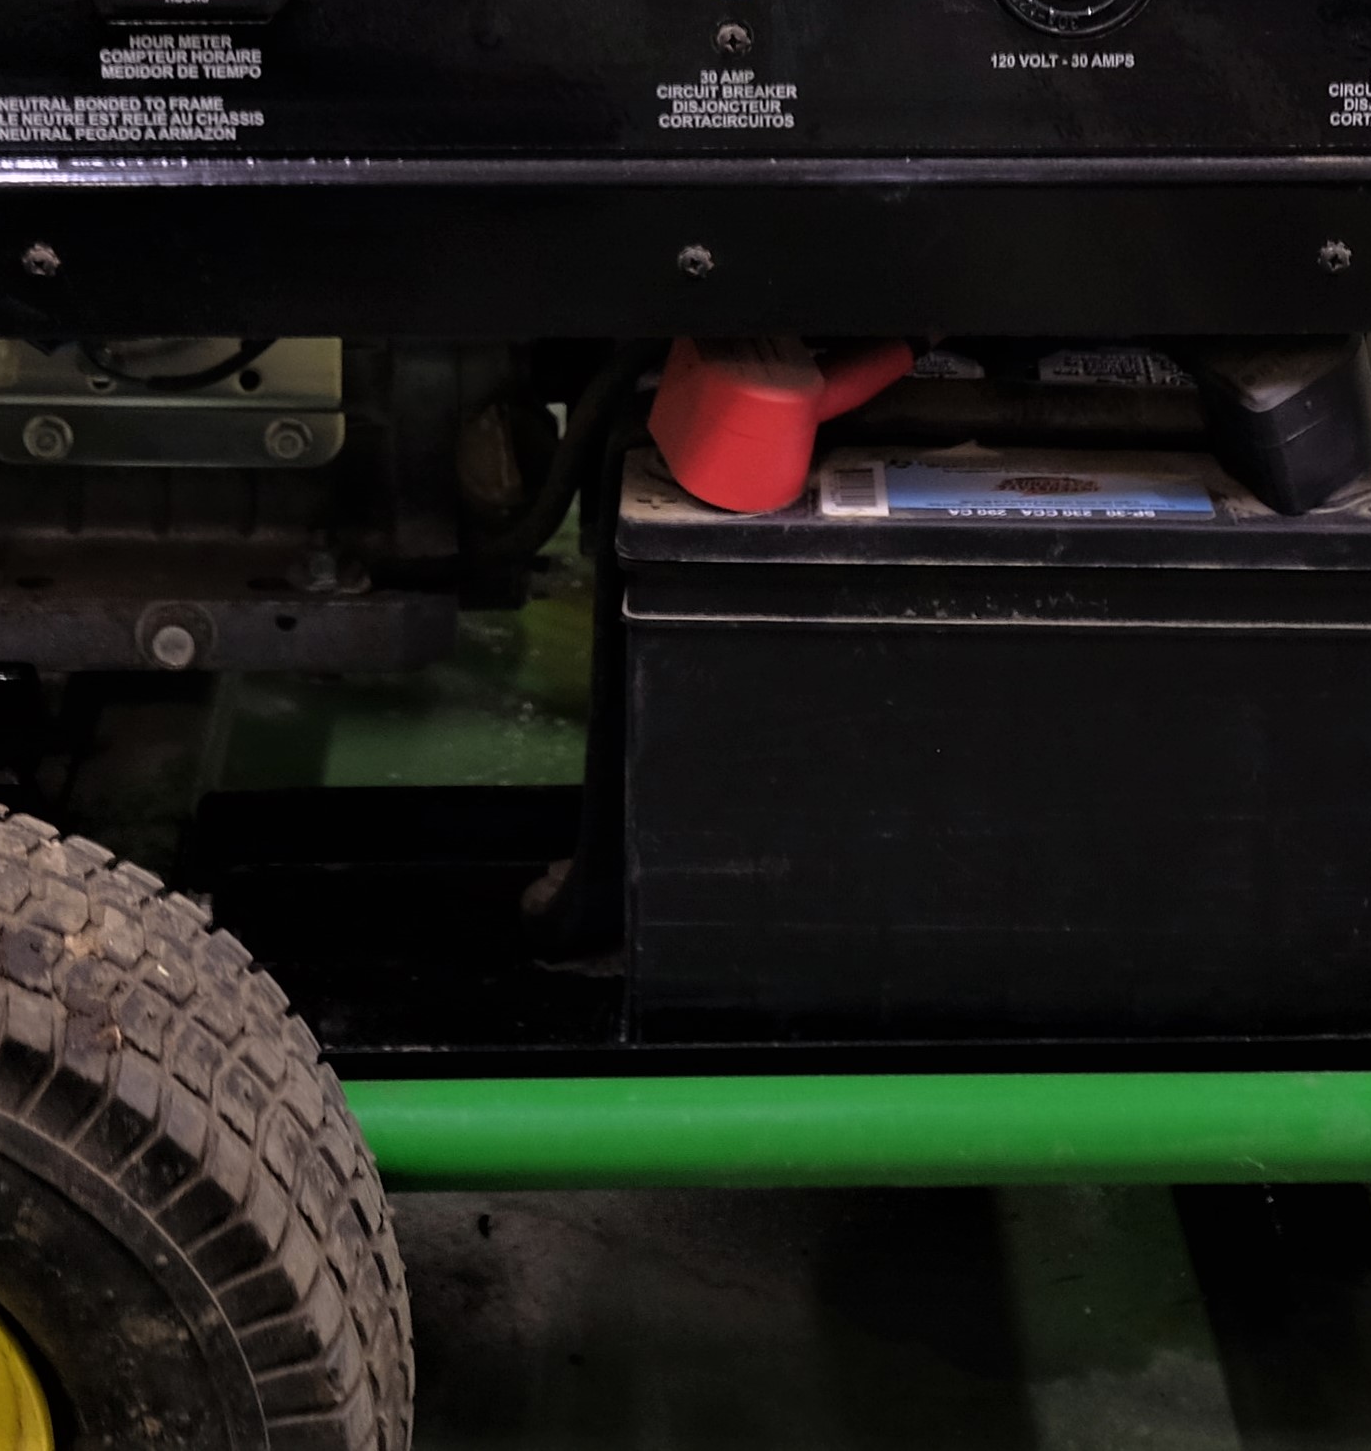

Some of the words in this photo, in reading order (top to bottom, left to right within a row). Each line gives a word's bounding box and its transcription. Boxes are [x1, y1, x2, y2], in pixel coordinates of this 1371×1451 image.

[129, 35, 175, 50] HOUR
[178, 35, 233, 50] METER
[99, 49, 188, 64] COMPTEUR
[190, 49, 262, 64] HORAIRE
[990, 53, 1016, 69] 120
[1018, 54, 1059, 68] VOLT
[1071, 54, 1089, 68] 30
[1091, 53, 1135, 68] AMPS
[100, 64, 174, 80] MEDIDOR
[176, 64, 199, 79] DE
[202, 64, 262, 79] TIEMPO
[700, 69, 718, 85] 30
[719, 70, 755, 85] AMP
[656, 84, 719, 99] CIRCUIT
[722, 84, 798, 99] BREAKER
[74, 98, 142, 112] BONDED
[144, 98, 166, 112] TO
[169, 98, 224, 112] FRAME
[672, 99, 782, 114] DISJONCTEUR
[21, 112, 85, 126] NEUTRE
[88, 112, 119, 126] EST
[170, 112, 193, 126] AU
[195, 112, 265, 126] CHASSIS
[658, 113, 795, 129] CORTACIRCUITOS
[74, 126, 142, 141] PEGADO
[144, 126, 157, 141] A
